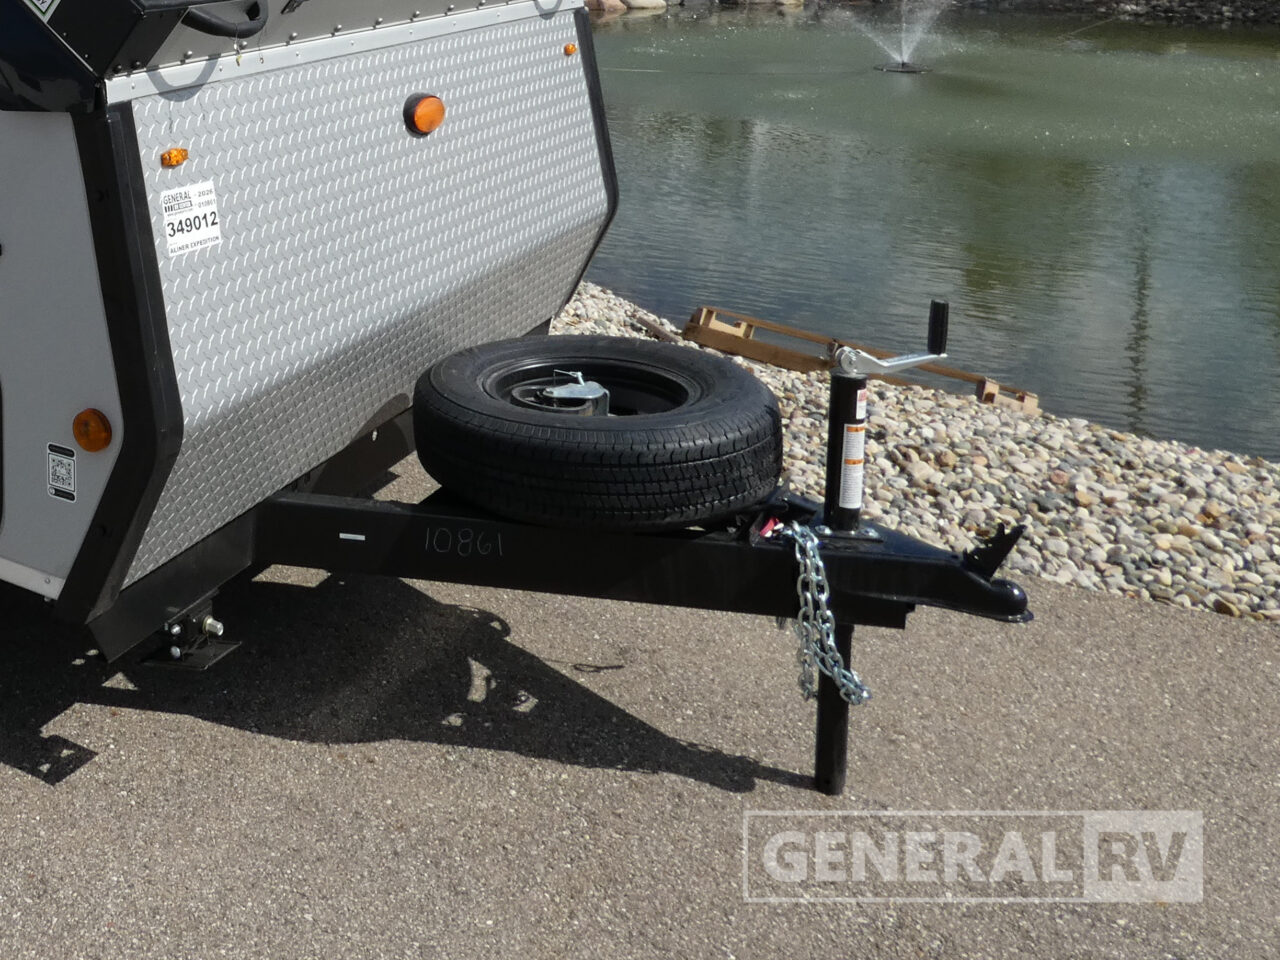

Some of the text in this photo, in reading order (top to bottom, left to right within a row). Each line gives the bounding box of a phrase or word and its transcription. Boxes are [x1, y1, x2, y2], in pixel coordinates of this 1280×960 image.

[163, 190, 192, 205] GENERAL
[167, 211, 218, 238] 349012
[170, 244, 189, 253] ALINER
[425, 527, 503, 557] 10861
